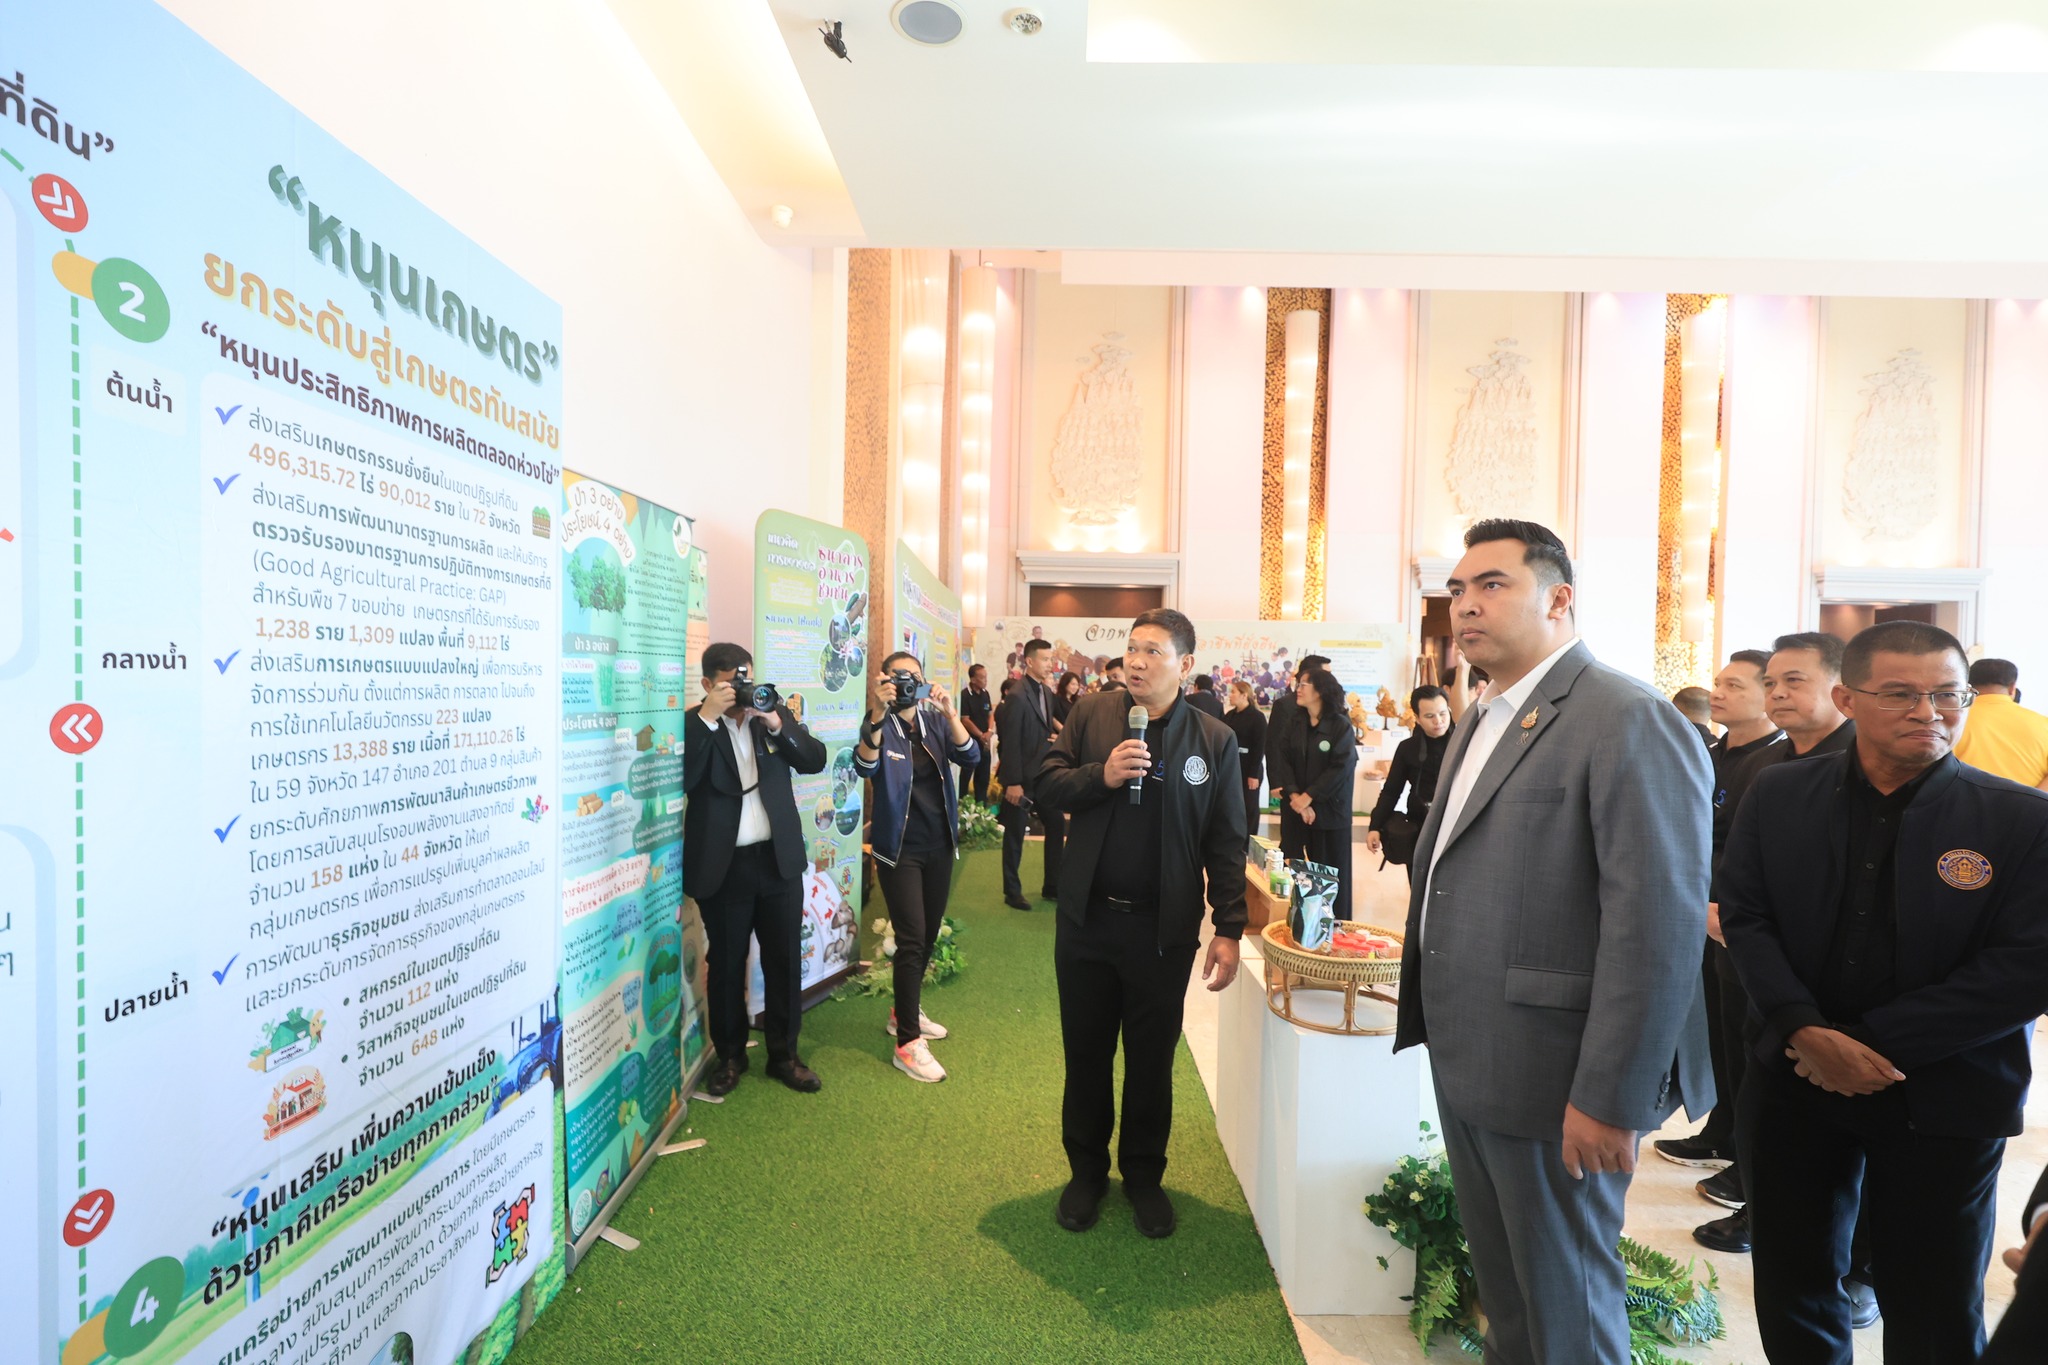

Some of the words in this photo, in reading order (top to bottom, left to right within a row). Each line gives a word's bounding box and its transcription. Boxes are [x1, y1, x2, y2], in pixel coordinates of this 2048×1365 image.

[268, 164, 559, 384] “หนุนเกษตร”
[117, 281, 146, 323] 2
[203, 251, 560, 449] ยกระดับสู่เกษตรทันสมัย
[105, 370, 174, 414] ต้นน้ำ
[201, 320, 560, 486] “หนุนประสิทธิภาพการผลิตตลอดห่วงโซ่”
[249, 442, 356, 490] 496,315.72
[359, 472, 375, 494] ไร่
[380, 480, 431, 511] 90,012
[434, 497, 455, 517] ราย
[473, 508, 487, 525] 72
[489, 512, 521, 536] จังหวัด
[589, 487, 597, 504] 3
[253, 548, 314, 579] (Good
[321, 560, 416, 592] Agricultural
[420, 578, 476, 601] Practice:
[479, 586, 507, 606] GAP)
[252, 586, 333, 611] สำหรับพืช
[339, 593, 347, 611] 7
[352, 596, 405, 618] ขอบข่าย
[255, 617, 310, 642] 1,238
[315, 624, 345, 642] ราย
[348, 624, 395, 646] 1,309
[399, 630, 435, 647] แปลง
[438, 624, 465, 649] พื้นที่
[467, 634, 498, 652] 9,112
[500, 634, 510, 651] ไร่
[1085, 623, 1130, 642] จากพ
[101, 642, 189, 671] กลางน้ำ
[250, 682, 359, 705] จัดการร่วมกัน
[436, 709, 459, 726] 223
[462, 707, 492, 724] แปลง
[250, 745, 328, 771] เกษตรกร
[332, 739, 388, 762] 13,388
[391, 742, 416, 756] ราย
[419, 727, 451, 752] เนื้อที่
[453, 728, 514, 749] 171,110.26
[516, 726, 526, 743] ไร่
[250, 779, 269, 804] ใน
[276, 778, 302, 800] 59
[307, 770, 358, 795] จังหวัด
[361, 766, 389, 788] 147
[392, 761, 430, 782] อำเภอ
[433, 757, 457, 778] 201
[459, 754, 488, 774] ตำบล
[490, 753, 498, 769] 9
[249, 875, 306, 907] จำนวน
[310, 864, 343, 890] 158
[348, 856, 379, 880] แห่ง
[383, 849, 397, 870] ใน
[401, 844, 420, 863] 44
[423, 837, 463, 859] จังหวัด
[249, 892, 360, 940] กลุ่มเกษตรกร
[103, 971, 190, 1024] ปลายน้ำ
[358, 998, 404, 1030] จำนวน
[407, 981, 432, 1007] 112
[435, 968, 460, 993] แห่ง
[358, 1052, 404, 1087] จำนวน
[411, 1029, 438, 1057] 648
[441, 1015, 466, 1040] แห่ง
[130, 1287, 159, 1328] 4
